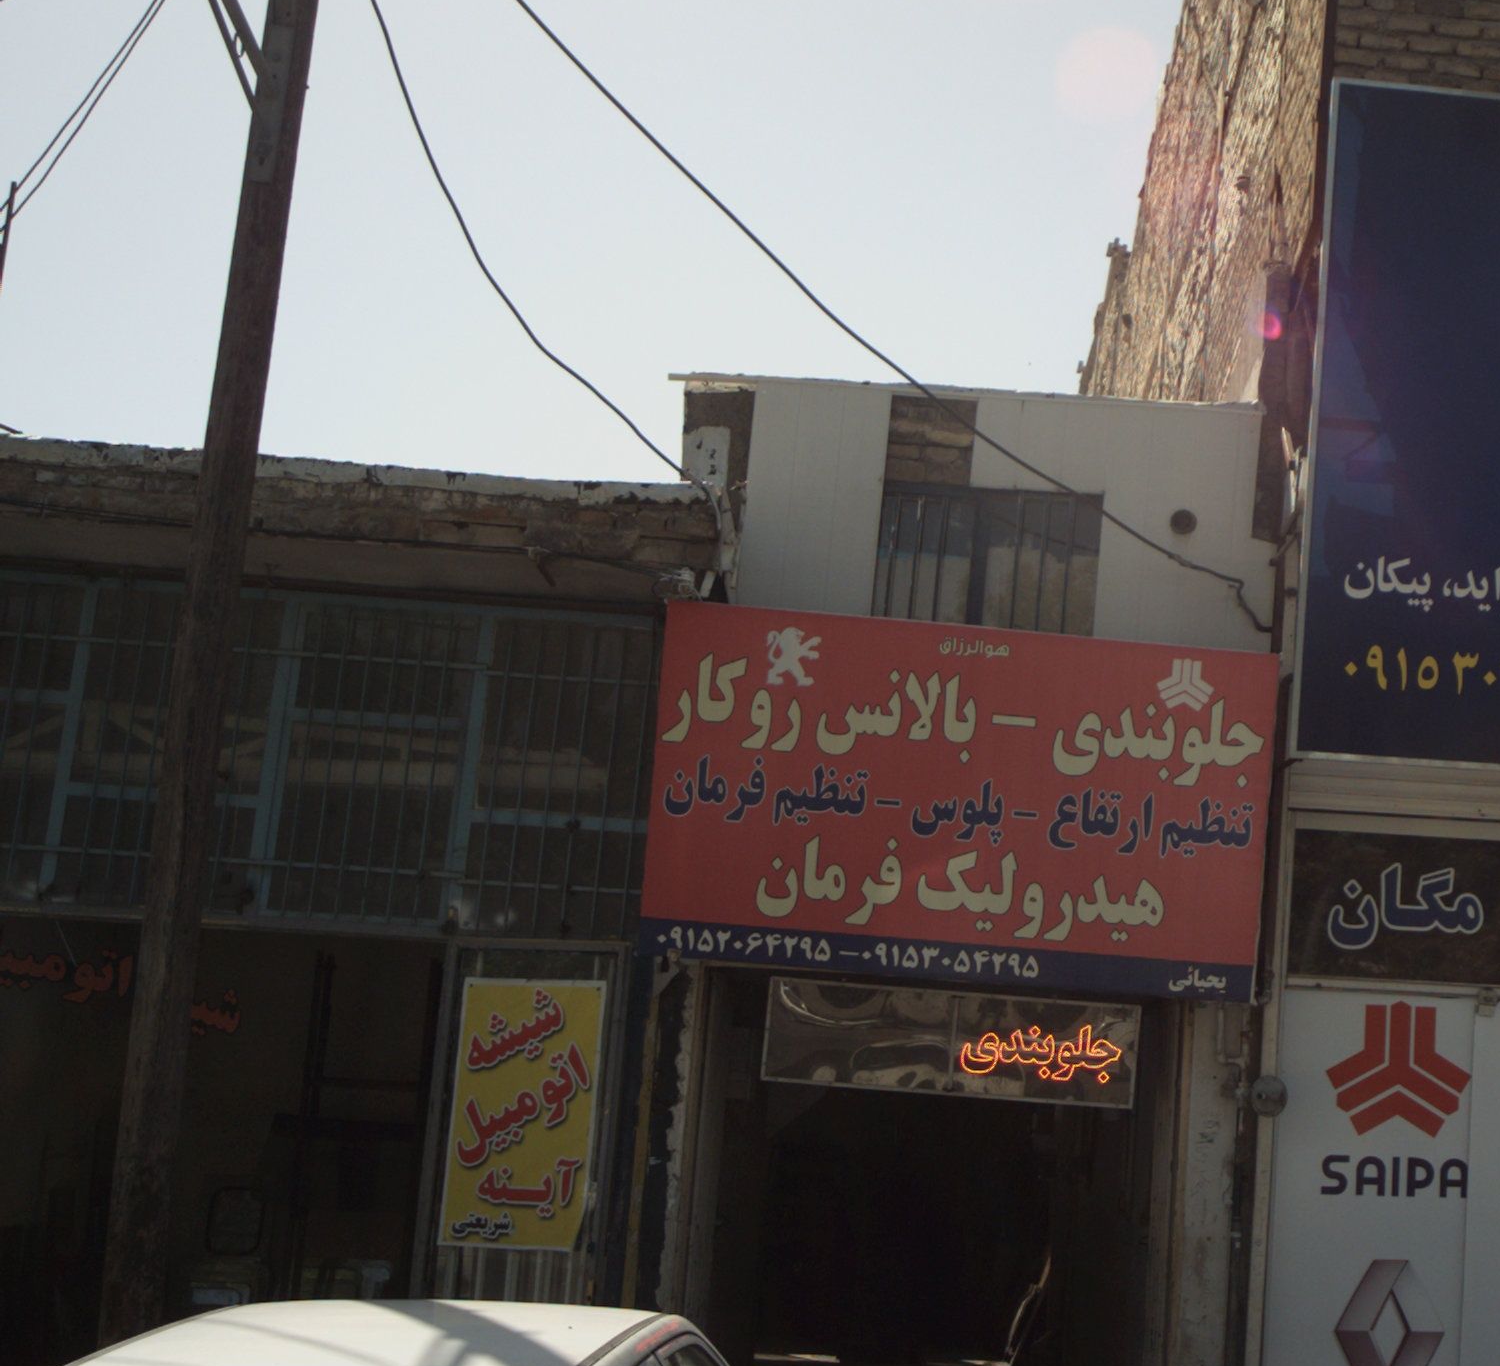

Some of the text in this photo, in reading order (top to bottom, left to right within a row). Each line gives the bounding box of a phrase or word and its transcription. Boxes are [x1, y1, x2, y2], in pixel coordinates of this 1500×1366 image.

[1343, 556, 1431, 612] پیکان
[816, 669, 977, 762] بالانس
[1053, 697, 1266, 788] جلوبندی
[663, 755, 768, 824] فرمان
[773, 764, 867, 825] تنظیم
[910, 780, 1005, 847] پلوس
[1047, 789, 1154, 856] ارتفاع
[1160, 801, 1255, 858] تنظیم
[755, 837, 1165, 943] هیدرولیک فرمان
[1327, 863, 1484, 949] مگان
[0, 948, 134, 1004] اتومبی
[467, 987, 565, 1070] شیشه
[960, 1025, 1122, 1083] جلوبندی
[456, 1042, 590, 1166] اتومبیل
[477, 1158, 581, 1217] آینه
[1320, 1154, 1468, 1198] SAIPA
[452, 1212, 512, 1239] شریعتی
